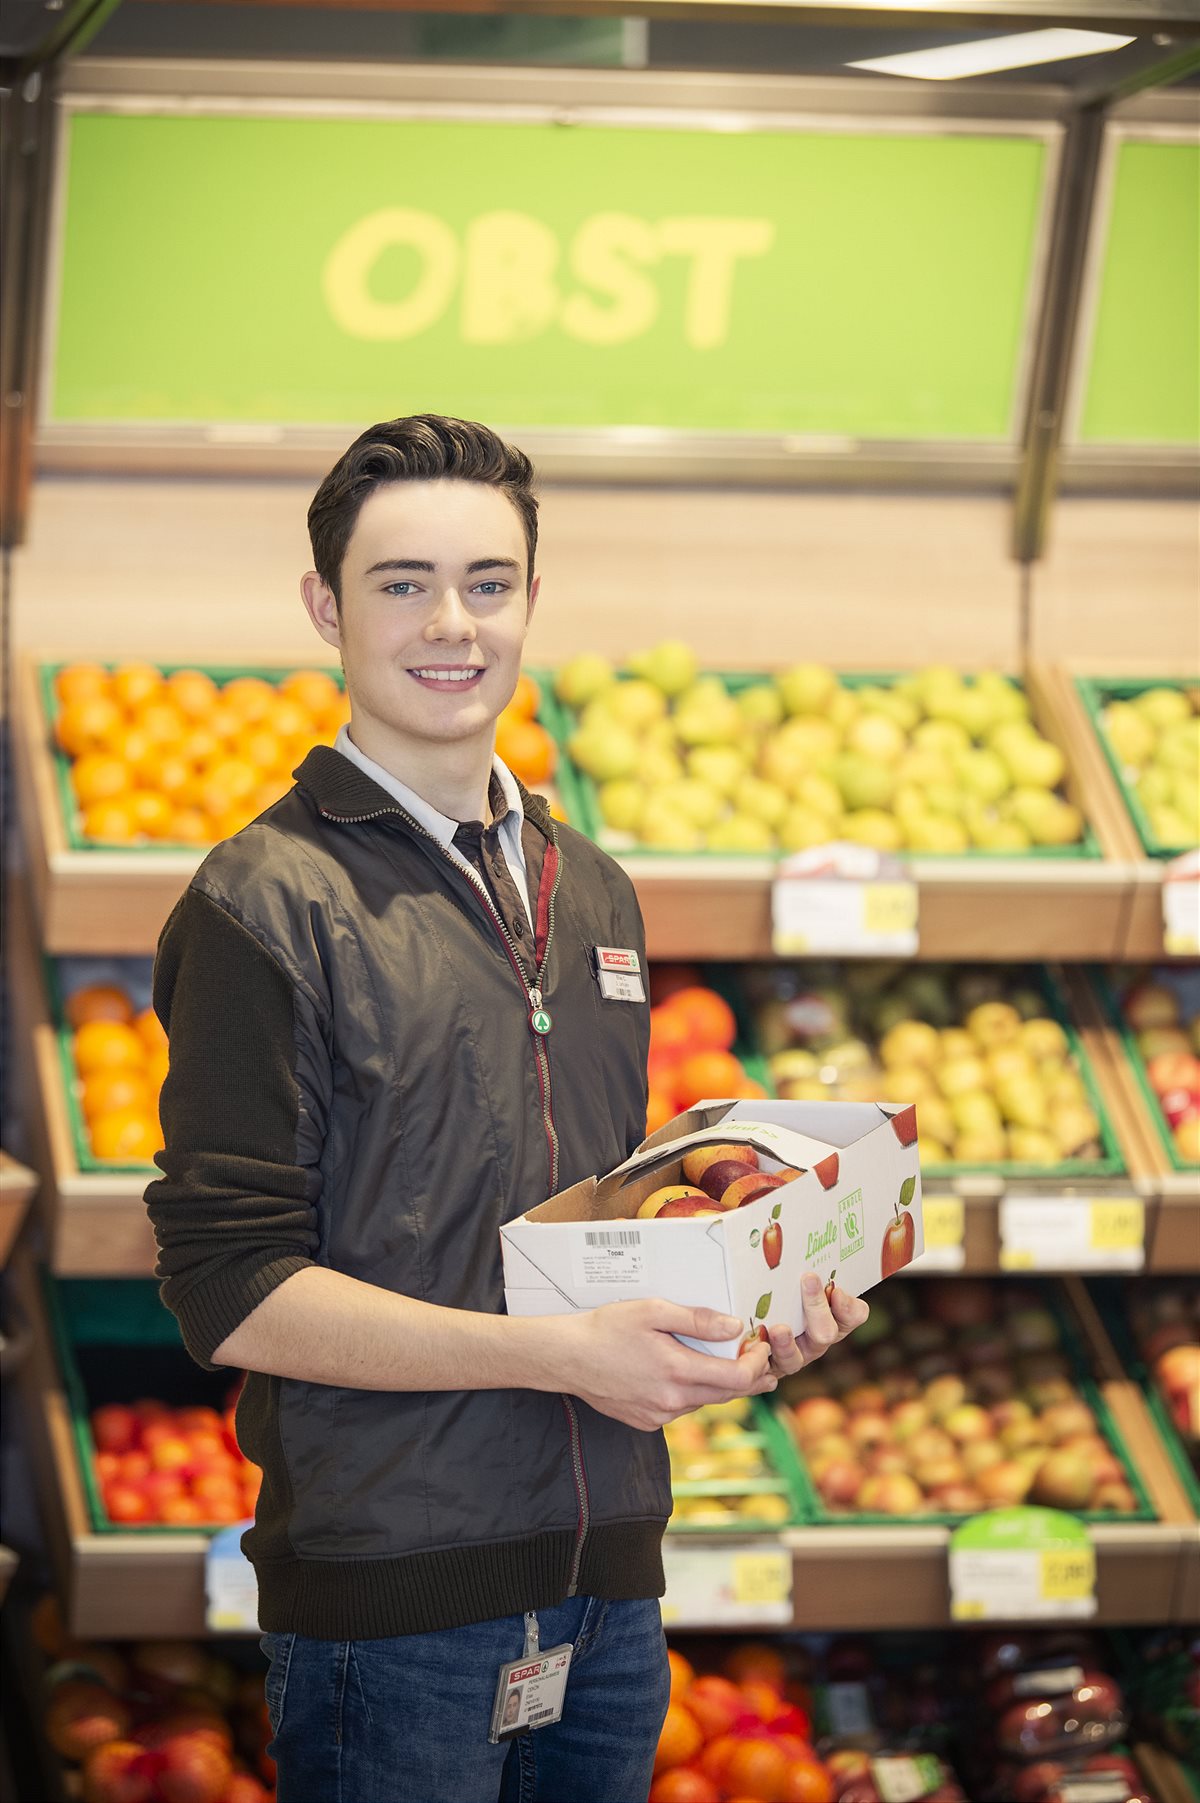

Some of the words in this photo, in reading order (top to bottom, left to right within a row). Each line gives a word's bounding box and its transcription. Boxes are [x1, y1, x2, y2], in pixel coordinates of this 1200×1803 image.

[321, 205, 776, 350] OBST
[604, 955, 630, 965] SPAR
[805, 1220, 837, 1260] Ländle
[513, 1665, 541, 1681] SPAR
